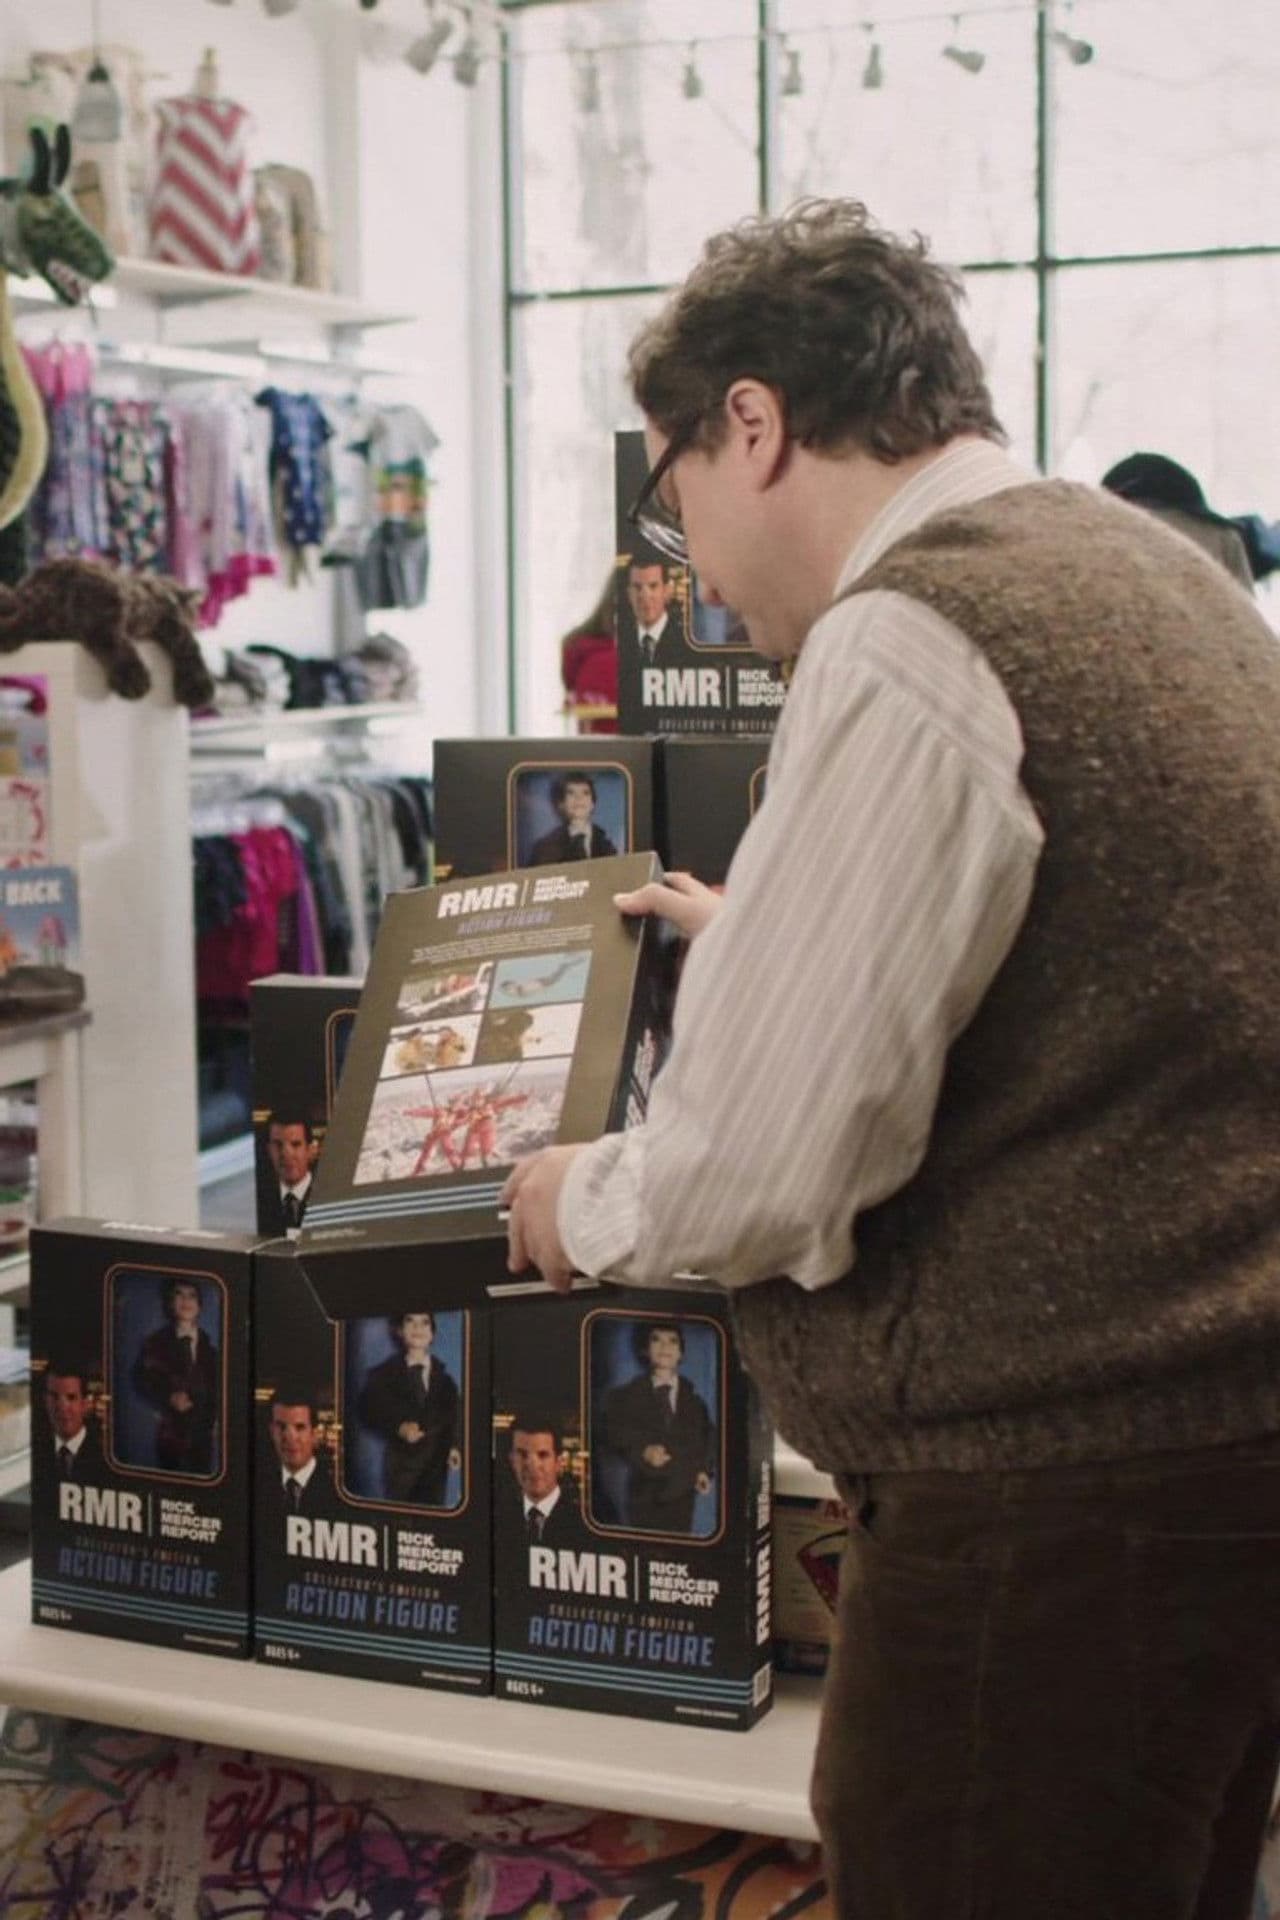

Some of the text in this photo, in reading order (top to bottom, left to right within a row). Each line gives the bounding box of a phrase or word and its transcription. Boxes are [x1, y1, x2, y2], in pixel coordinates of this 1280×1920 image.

[738, 669, 770, 681] RICK
[642, 668, 721, 707] RMR
[437, 881, 518, 919] RMR
[59, 1482, 143, 1534] RMR
[160, 1499, 195, 1515] RICK
[160, 1512, 222, 1531] MERCER
[160, 1525, 218, 1544] REPORT
[286, 1515, 378, 1567] RMR
[397, 1531, 435, 1547] RICK
[397, 1545, 464, 1563] MERCER
[58, 1547, 219, 1600] ACTION FIGURE
[397, 1558, 460, 1576] REPORT
[529, 1545, 628, 1599] RMR
[648, 1561, 689, 1577] RICK
[648, 1575, 720, 1594] MERCER
[648, 1588, 715, 1608] REPORT
[285, 1583, 460, 1635] ACTION FIGURE
[528, 1616, 715, 1668] ACTION FIGURE
